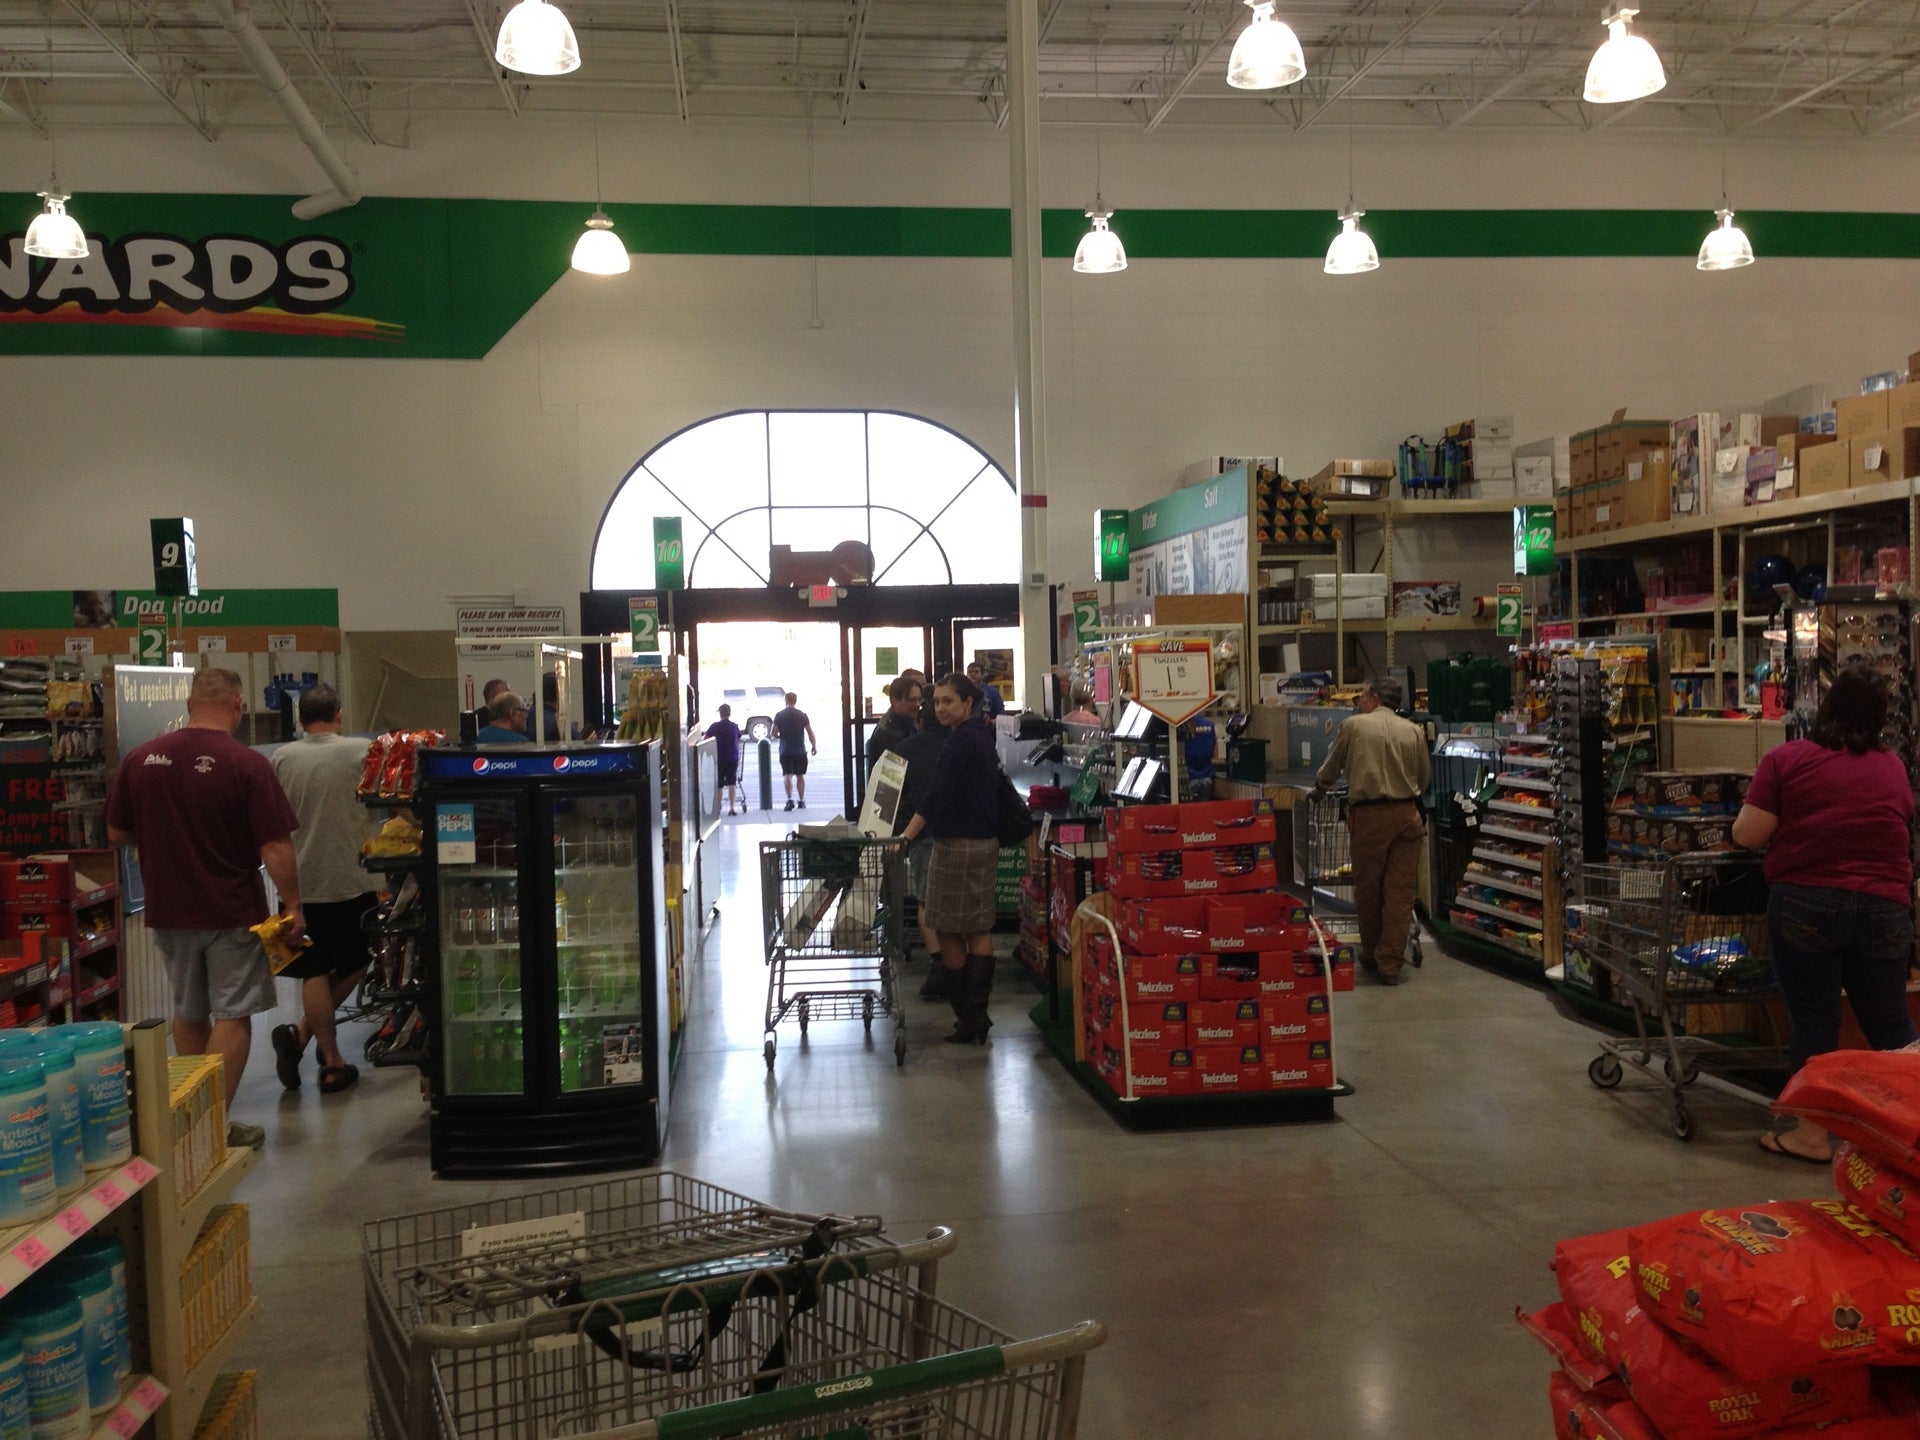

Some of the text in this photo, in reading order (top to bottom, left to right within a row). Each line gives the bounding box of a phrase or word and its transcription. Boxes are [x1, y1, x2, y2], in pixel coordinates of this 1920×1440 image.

[1105, 532, 1126, 557] 11
[1529, 527, 1552, 550] 12
[161, 542, 179, 568] 9
[655, 538, 682, 564] 10
[123, 594, 225, 615] Dog Food
[460, 610, 561, 619] PLEASE SAVE YOUR RECEIPTS
[1160, 641, 1185, 652] SAVE
[490, 760, 517, 772] pepsi
[571, 758, 598, 769] pepsi
[8, 778, 66, 801] FRE
[438, 821, 472, 832] PEPSI
[1182, 832, 1217, 844] Twizzlers
[1183, 879, 1218, 890] Twizzlers
[1209, 937, 1244, 948] Twizzlers
[1137, 981, 1174, 993] Twizzlers
[1261, 980, 1295, 992] Twizzlers
[1128, 1029, 1161, 1040] wizzlers
[1197, 1027, 1234, 1039] Twizzlers
[1270, 1023, 1306, 1036] Twizzlers
[1202, 1072, 1238, 1084] Twizzlers
[1271, 1069, 1308, 1082] Twizzlers
[1847, 1152, 1877, 1182] ROYAL
[504, 1236, 524, 1245] would
[548, 1229, 568, 1237] check
[1638, 1263, 1671, 1291] ROYAL
[814, 1375, 873, 1398] MENARDS
[1709, 1391, 1761, 1412] ROYAL
[1719, 1405, 1755, 1424] OAK
